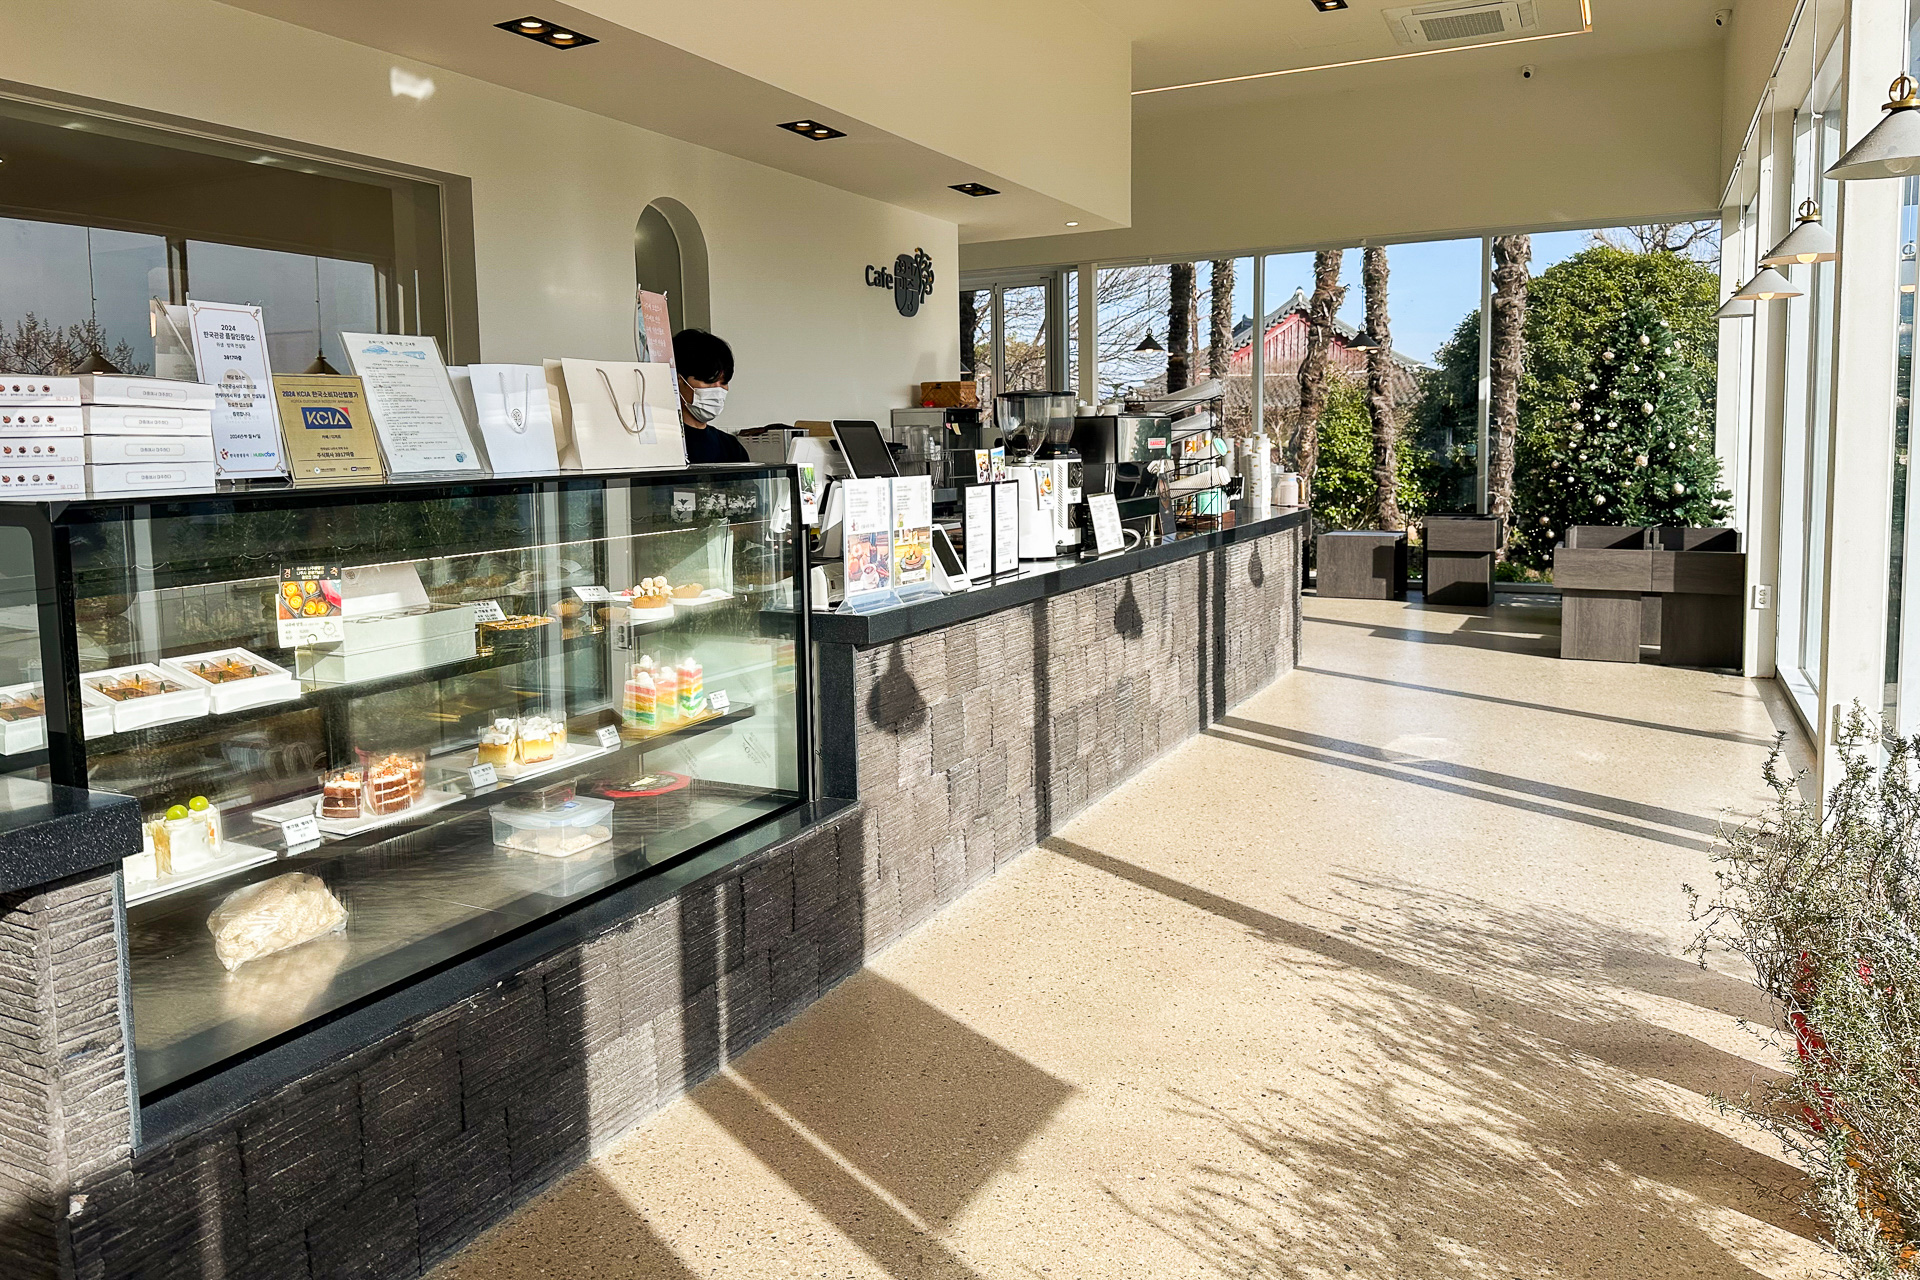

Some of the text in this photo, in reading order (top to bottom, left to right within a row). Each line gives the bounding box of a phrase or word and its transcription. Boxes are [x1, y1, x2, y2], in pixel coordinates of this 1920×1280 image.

[865, 264, 893, 290] Cafe
[226, 333, 255, 341] 품질인증업소
[306, 412, 346, 425] KCIA
[284, 568, 291, 578] 경
[330, 566, 338, 576] 축
